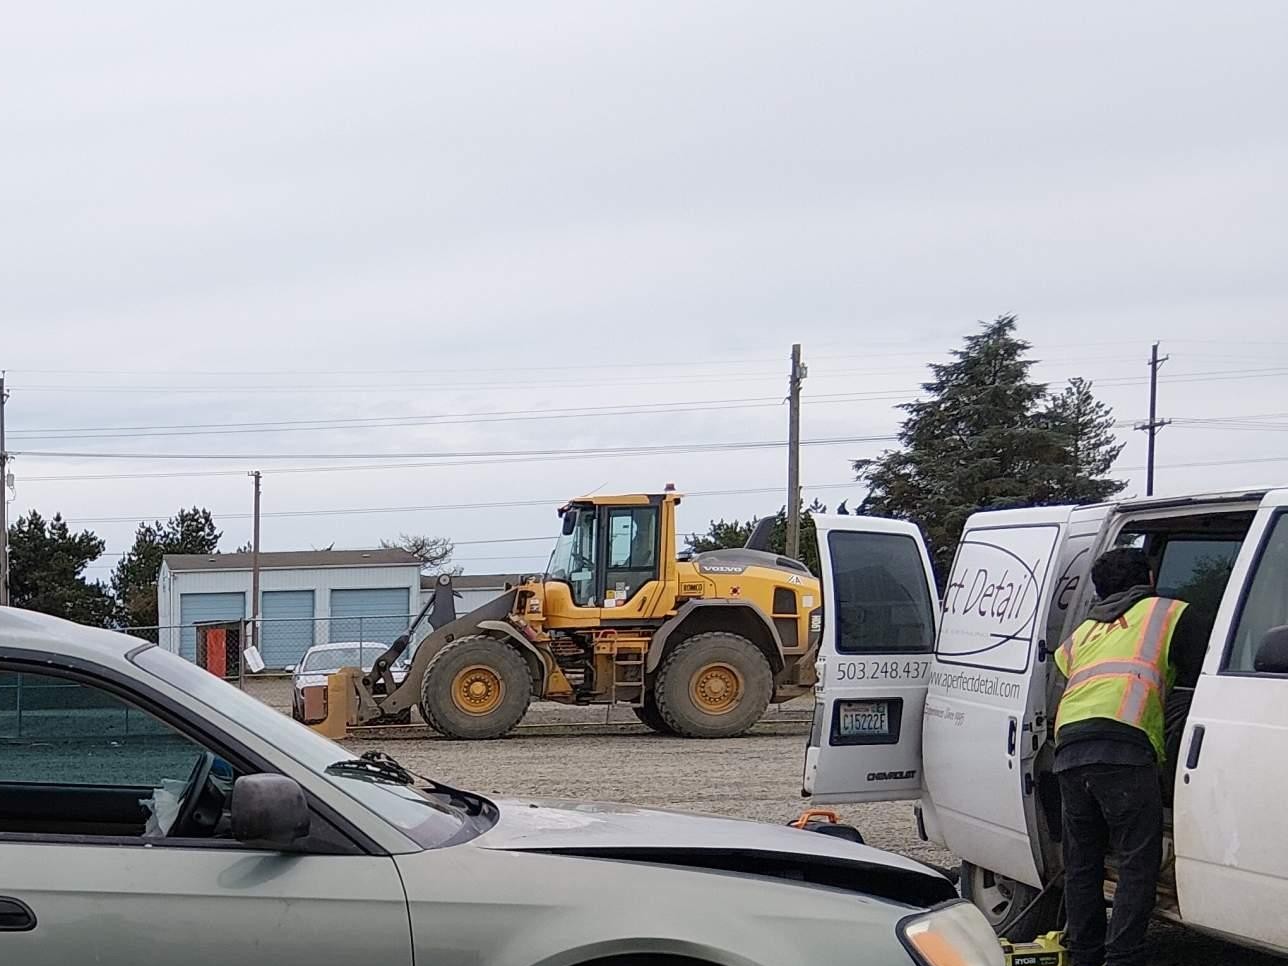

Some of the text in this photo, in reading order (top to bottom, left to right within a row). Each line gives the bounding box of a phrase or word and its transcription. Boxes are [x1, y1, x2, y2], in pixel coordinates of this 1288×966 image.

[963, 558, 1040, 623] Detail
[843, 713, 886, 731] C15222F
[1015, 957, 1036, 965] RYOBI
